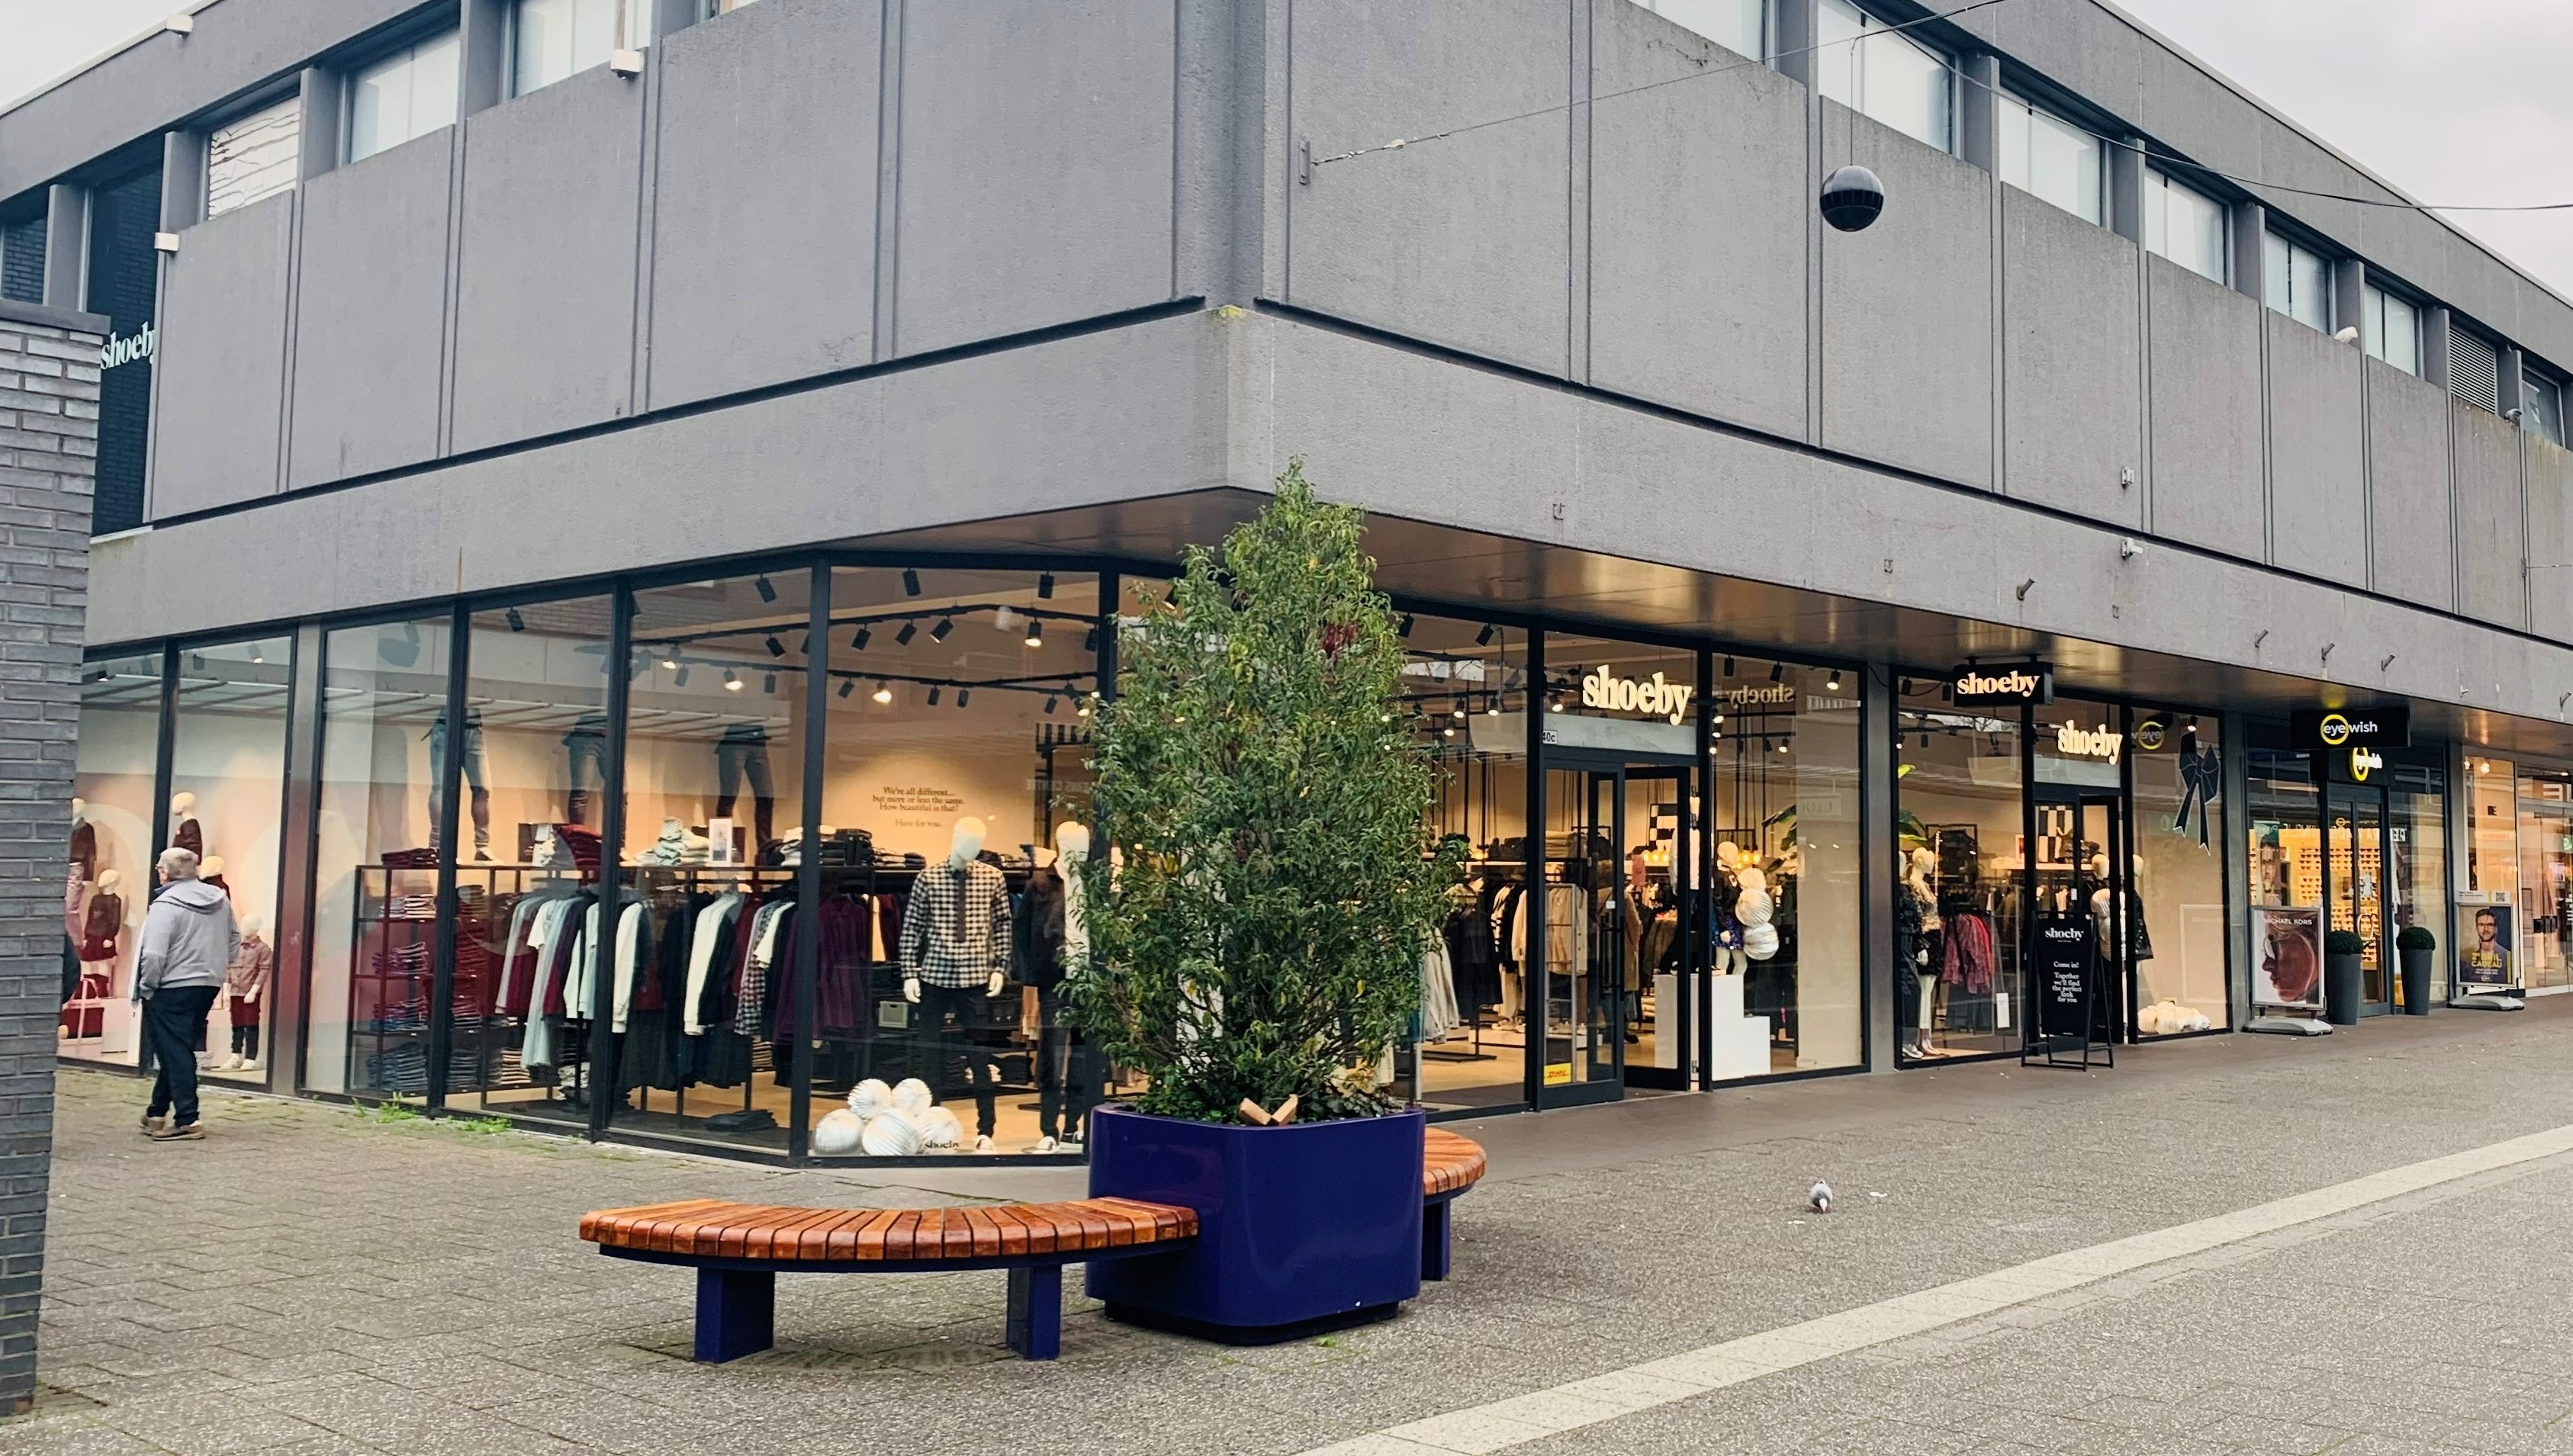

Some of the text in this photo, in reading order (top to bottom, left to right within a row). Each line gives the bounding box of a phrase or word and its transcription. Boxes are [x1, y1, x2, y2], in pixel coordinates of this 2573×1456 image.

[1957, 670, 2041, 697] shoeby
[1582, 664, 1693, 726] shoeby
[2057, 719, 2123, 766] shoeby
[883, 786, 904, 795] We're
[873, 794, 885, 802] but
[880, 802, 897, 810] How
[899, 802, 931, 811] beautiful
[896, 818, 913, 826] Here
[2045, 927, 2084, 941] shoeby
[2054, 972, 2079, 980] Together
